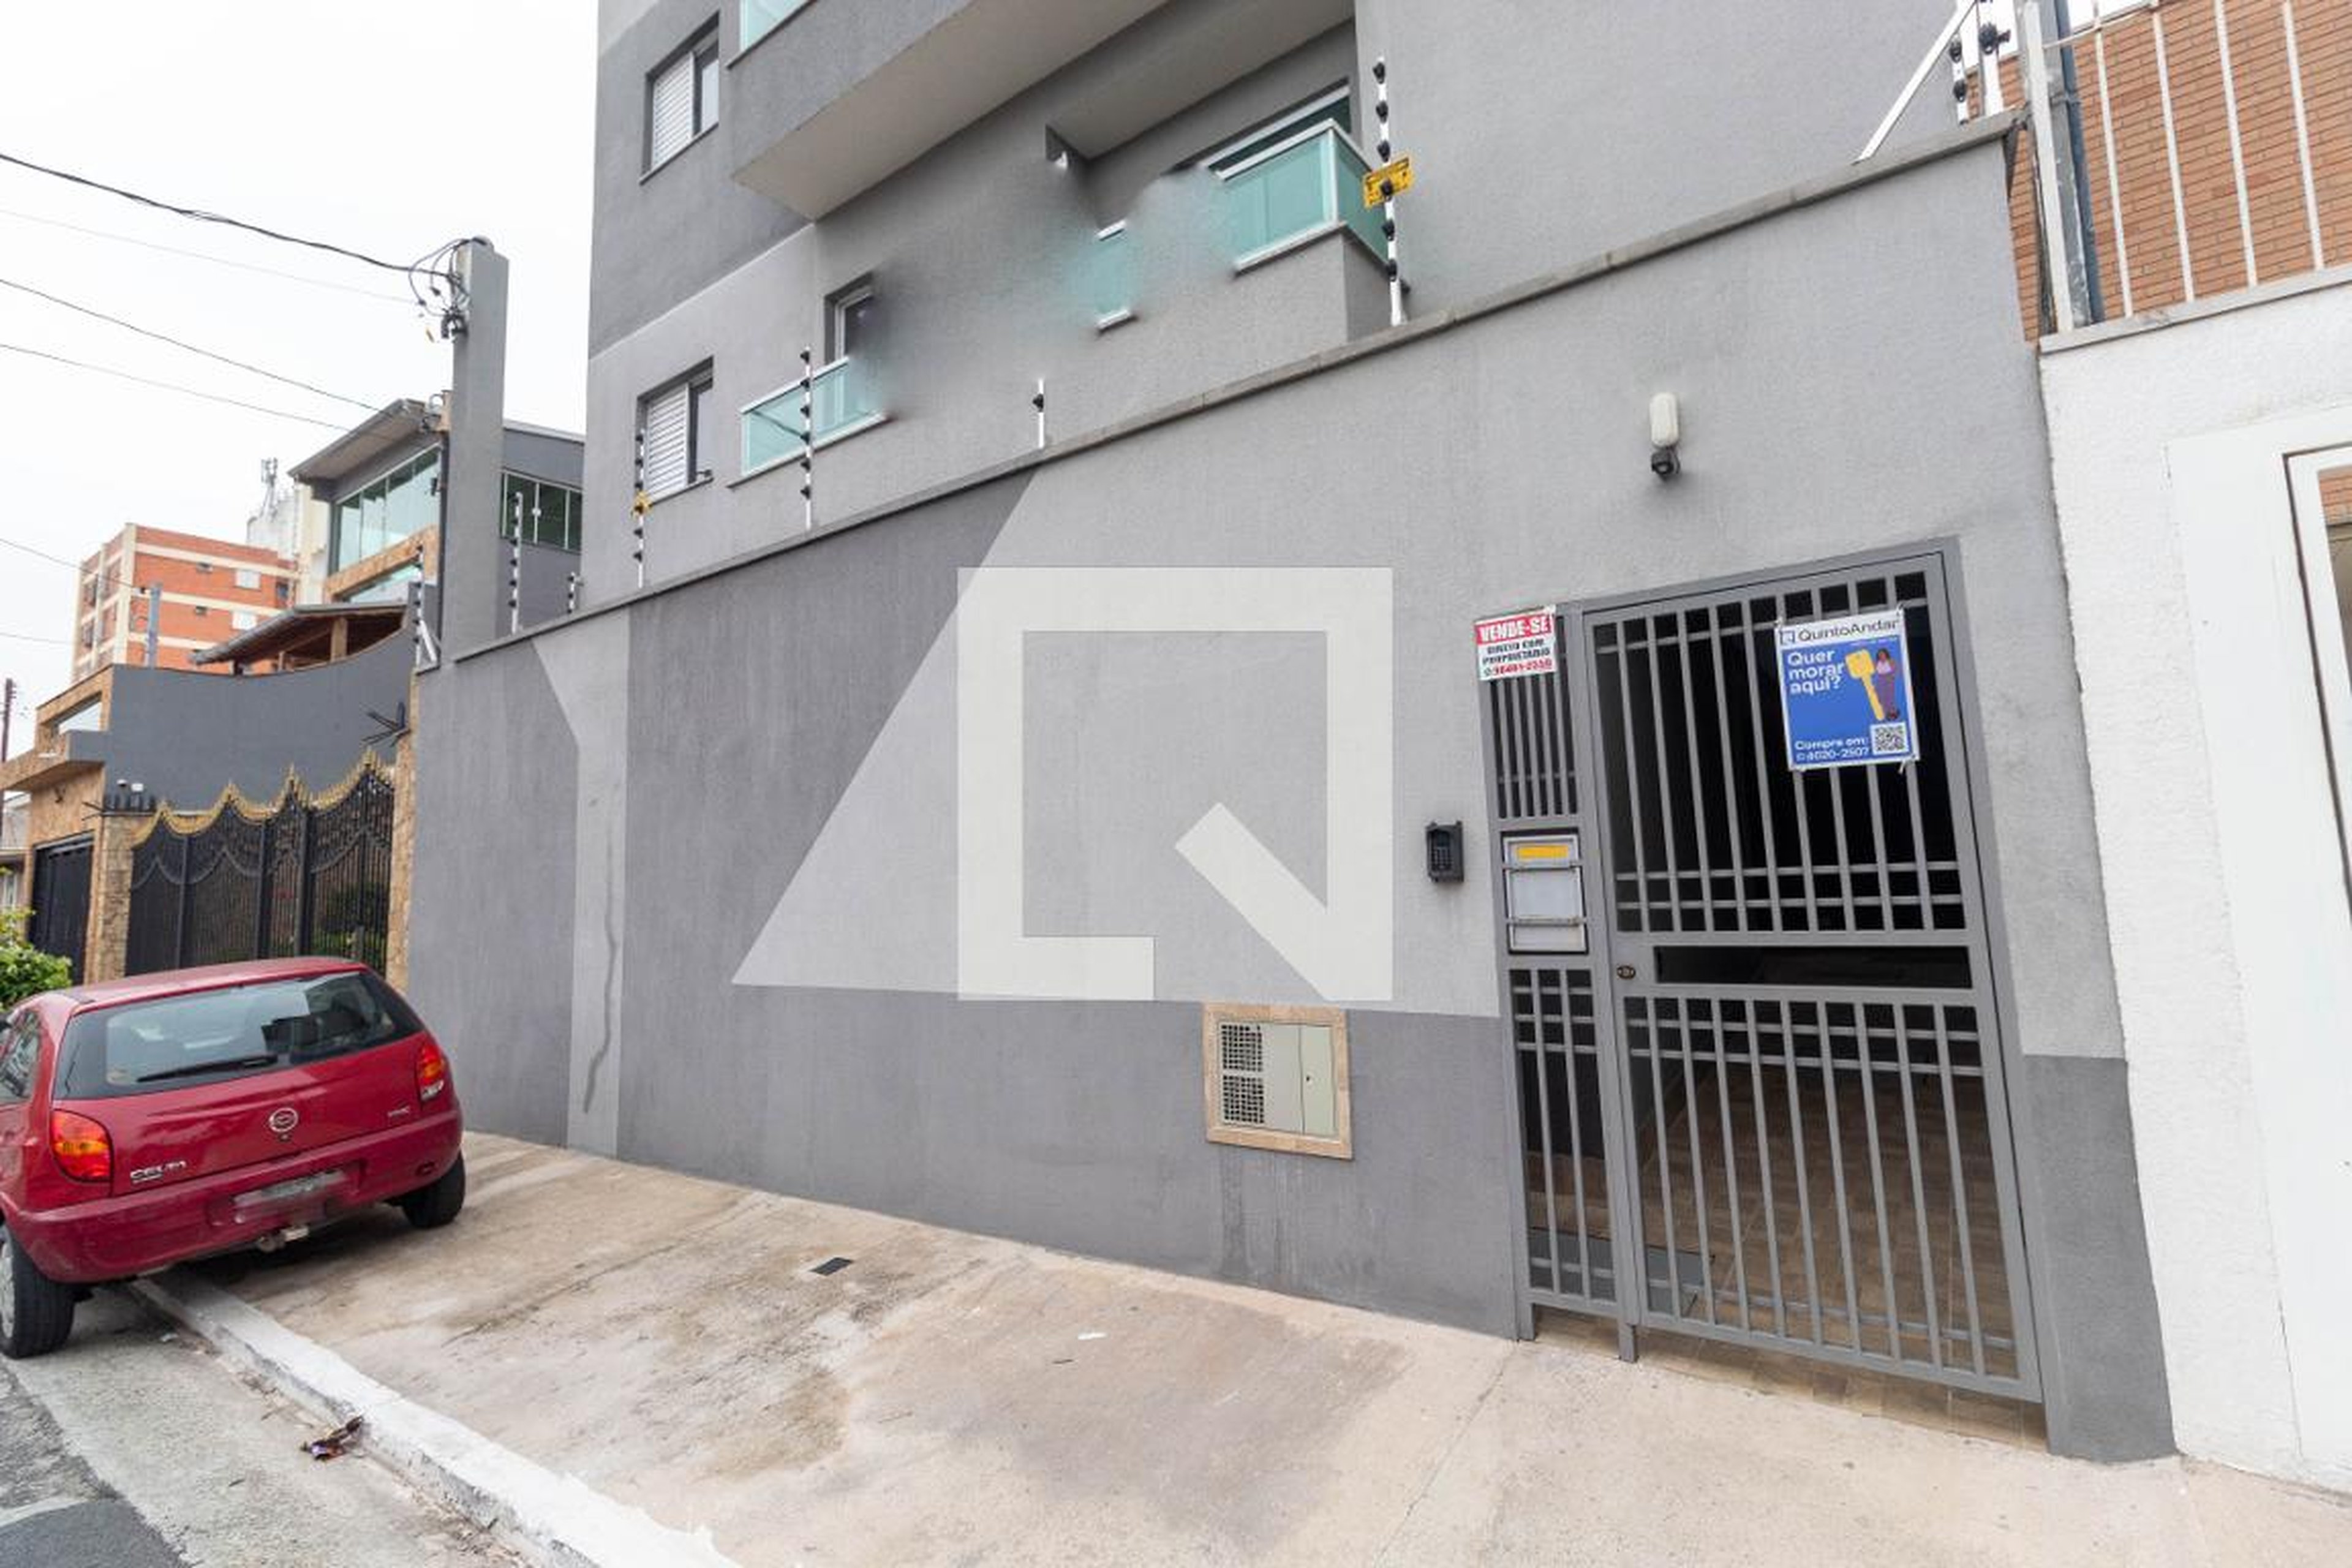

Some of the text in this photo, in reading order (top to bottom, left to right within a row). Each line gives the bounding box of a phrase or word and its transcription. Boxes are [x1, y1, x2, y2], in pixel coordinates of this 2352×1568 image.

[1479, 616, 1550, 643] VENDE-SE
[1798, 619, 1897, 642] QuintoAndar
[1787, 650, 1835, 667] Quer
[1789, 663, 1845, 680] morar
[1790, 675, 1841, 695] aqui?
[1795, 739, 1843, 750] Compre
